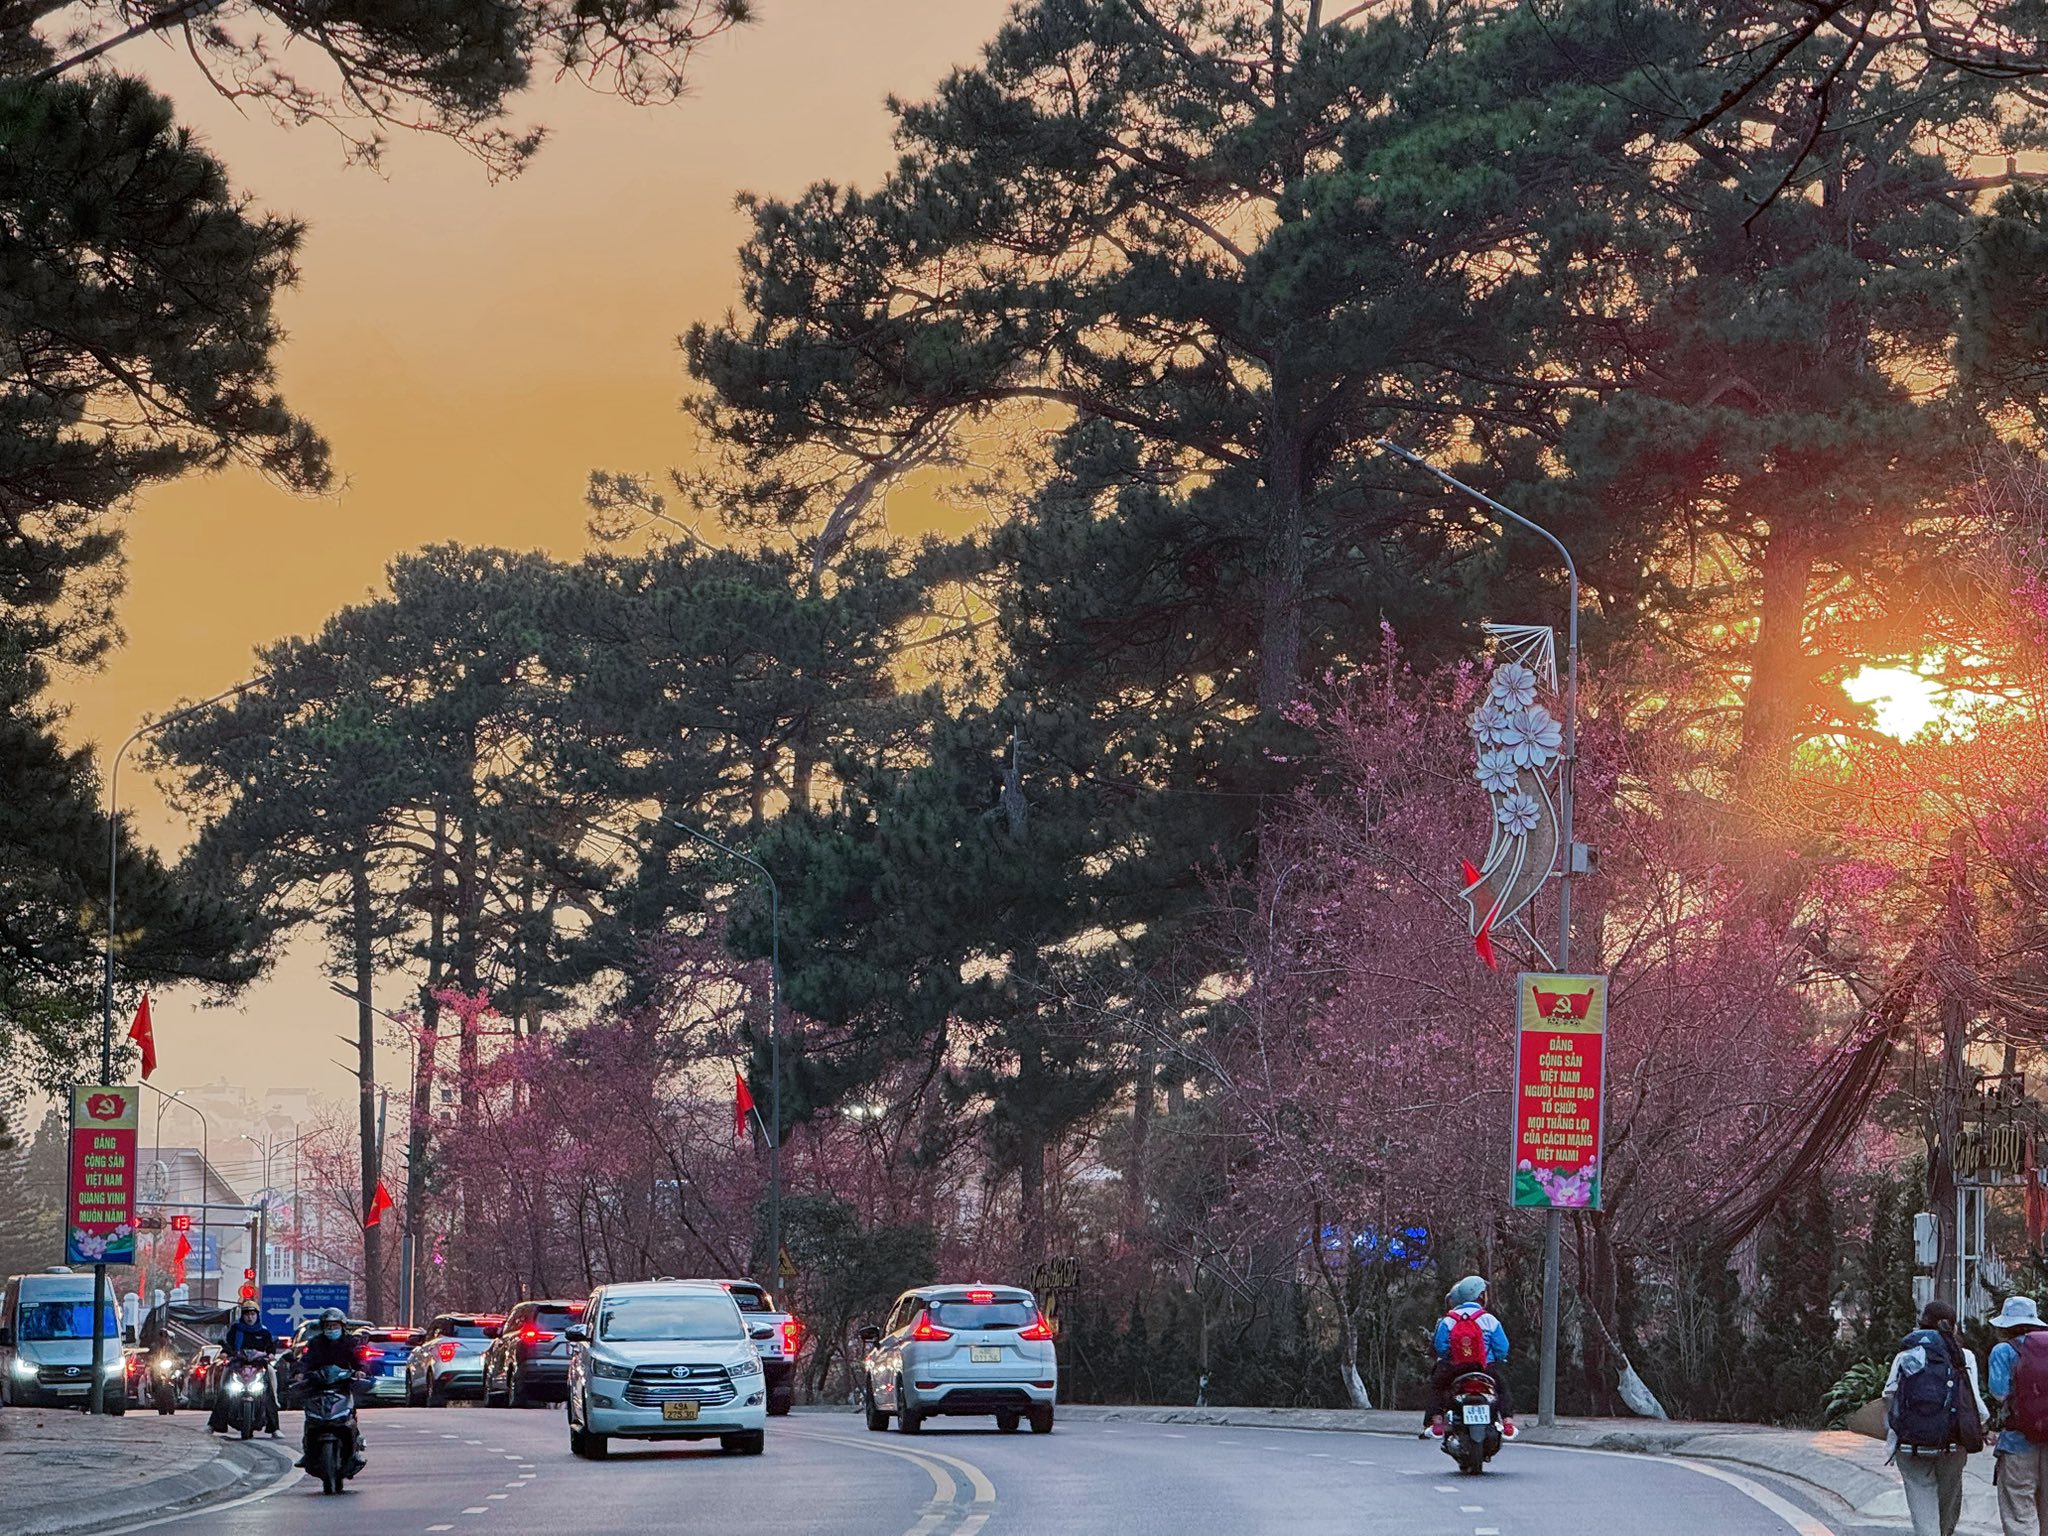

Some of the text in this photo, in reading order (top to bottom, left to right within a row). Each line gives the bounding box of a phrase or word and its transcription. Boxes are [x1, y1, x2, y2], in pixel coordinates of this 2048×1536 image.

[1550, 1035, 1573, 1052] ĐẢNG
[1540, 1052, 1583, 1069] CỘNG SẢN
[1541, 1068, 1580, 1085] VIỆT NAM
[1553, 1084, 1575, 1099] LÃNH
[1577, 1087, 1595, 1101] ĐẠO
[1554, 1100, 1577, 1114] CHỨC
[1528, 1114, 1590, 1133] MỌI THẮNG LỢI
[94, 1133, 116, 1149] ĐẢNG
[1523, 1129, 1593, 1148] CỦA CÁCH MẠNG
[1536, 1147, 1579, 1163] VIỆT NAM!
[1990, 1125, 2021, 1173] BBQ
[84, 1151, 125, 1170] CỘNG SẢN
[86, 1171, 123, 1189] VIỆT NAM
[79, 1192, 126, 1206] QUANG VINH
[79, 1208, 127, 1223] MUÔN NĂM!
[176, 1218, 187, 1229] 13
